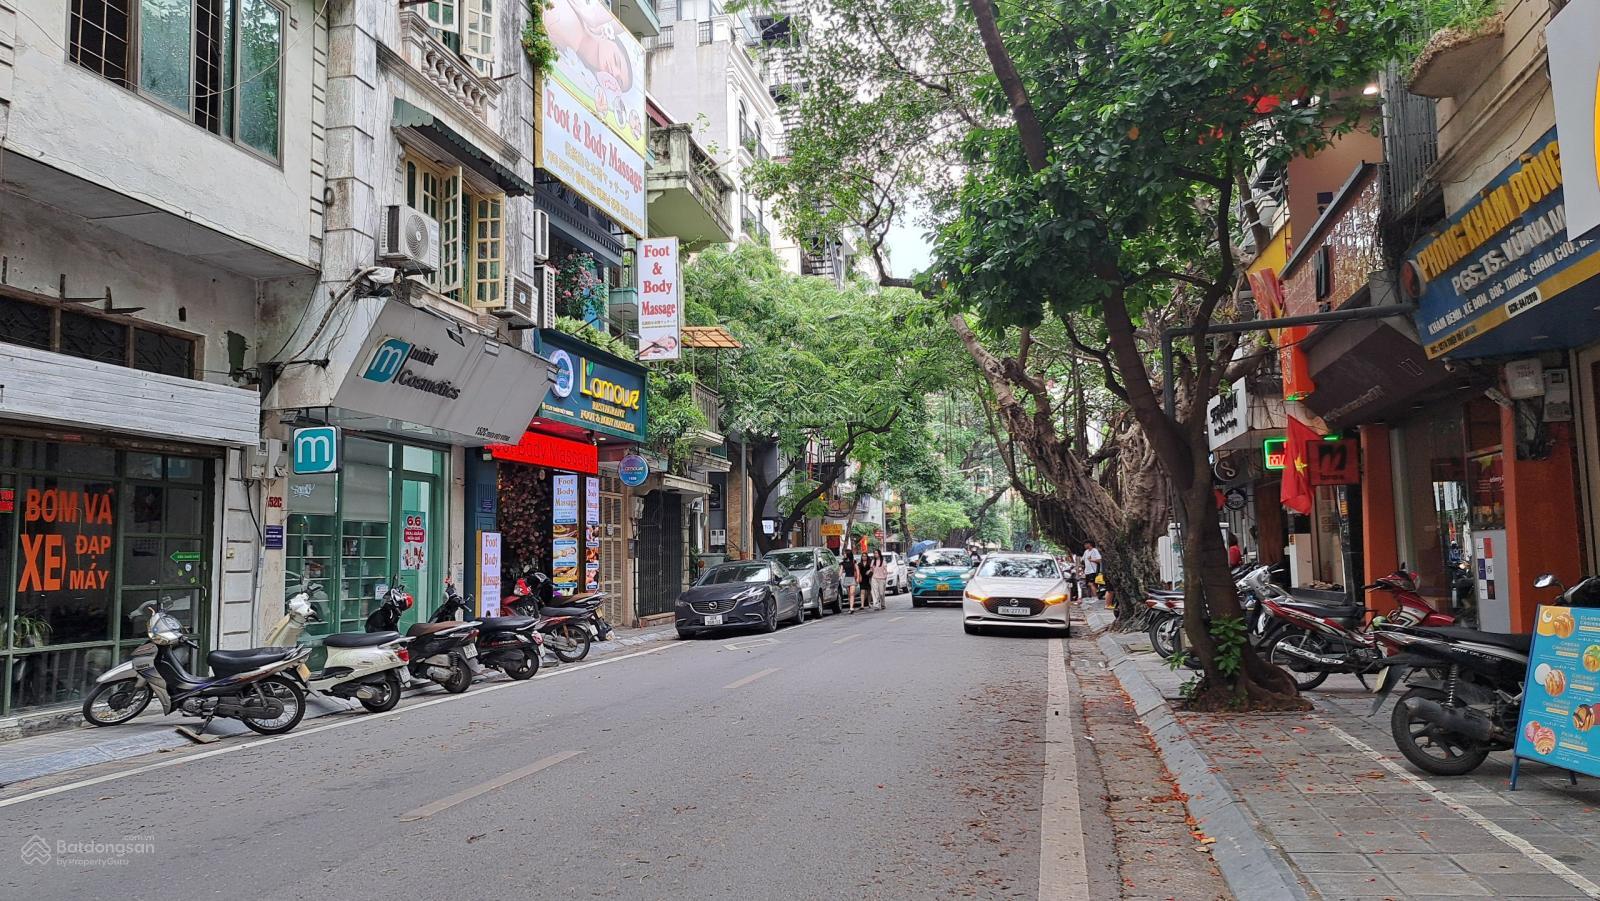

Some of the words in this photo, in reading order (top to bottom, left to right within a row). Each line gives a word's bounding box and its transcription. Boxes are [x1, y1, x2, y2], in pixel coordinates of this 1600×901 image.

[546, 88, 570, 133] Foot
[572, 112, 582, 143] &
[583, 120, 607, 167] Body
[608, 142, 643, 194] Massage
[644, 244, 670, 258] Foot
[652, 262, 663, 276] &
[643, 279, 672, 294] Body
[641, 301, 676, 317] Massage
[398, 369, 461, 400] Cosmetics
[558, 478, 574, 486] Foot
[556, 487, 575, 497] Body
[26, 488, 79, 523] BƠM
[83, 487, 115, 525] VÁ
[554, 499, 577, 507] Massage
[76, 535, 112, 560] ĐẠP
[485, 535, 498, 548] Foot
[18, 534, 62, 592] XE
[484, 553, 499, 568] Body
[69, 562, 110, 590] MÁY
[483, 572, 500, 589] Massage
